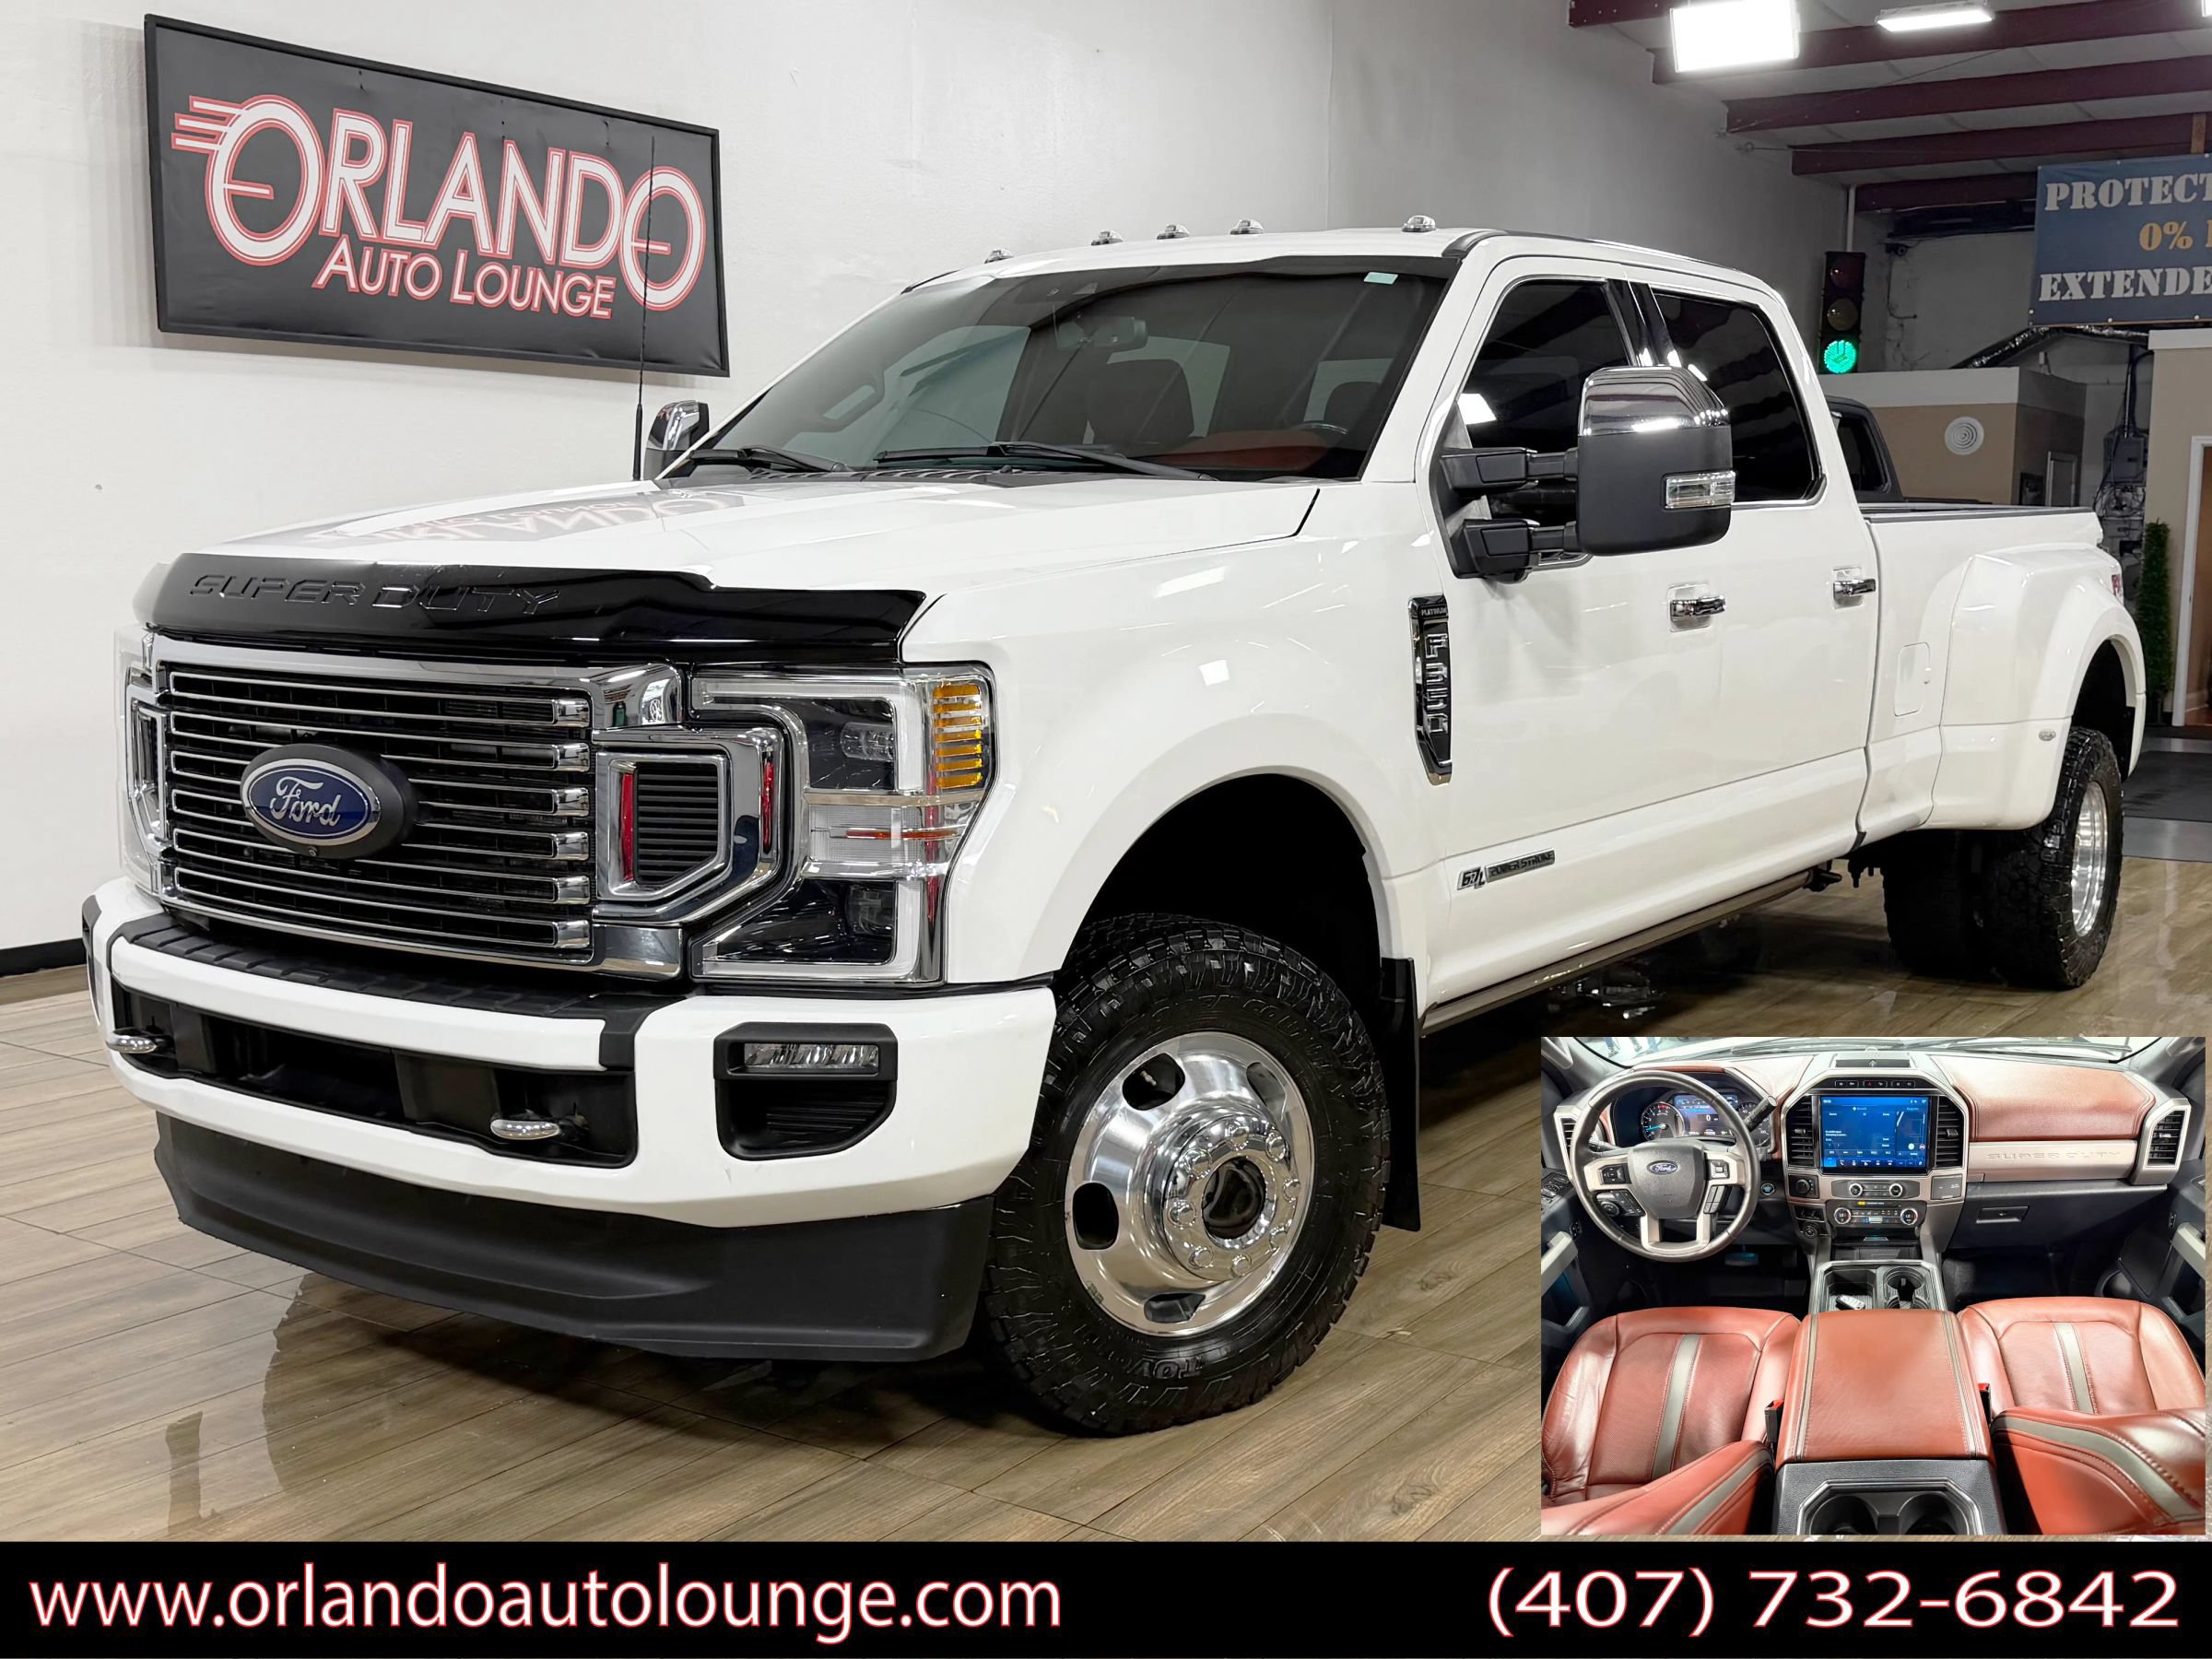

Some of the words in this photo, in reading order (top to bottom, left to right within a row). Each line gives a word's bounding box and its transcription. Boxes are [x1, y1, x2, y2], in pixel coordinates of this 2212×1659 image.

[173, 94, 705, 311] ORLANDO
[2044, 173, 2212, 211] PROTECT
[2139, 221, 2194, 251] 0%
[312, 234, 442, 300] AUTO
[450, 249, 617, 320] LOUNGE
[2039, 266, 2212, 301] EXTENDE
[189, 575, 366, 606] SUPER
[371, 583, 560, 615] DUTY
[269, 776, 342, 826] Ford
[1653, 1164, 1676, 1173] Ford
[2065, 1151, 2122, 1159] DUTY
